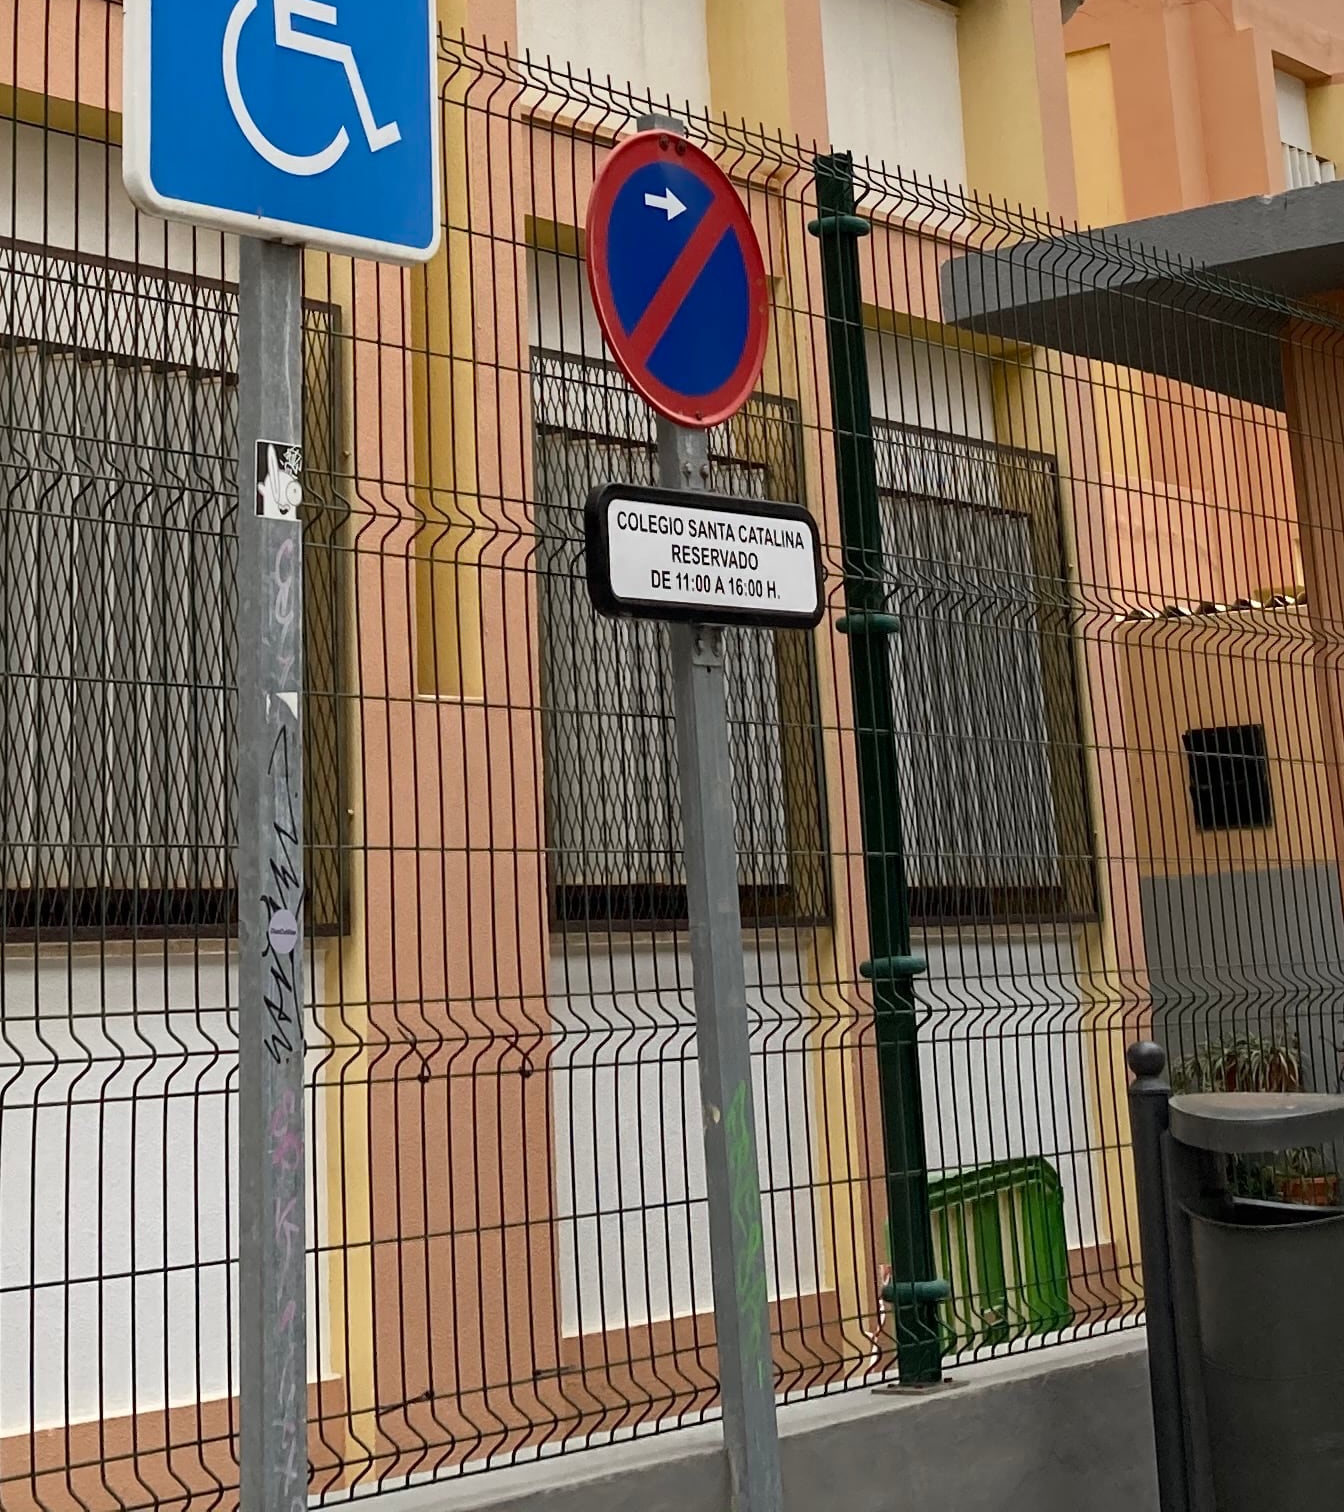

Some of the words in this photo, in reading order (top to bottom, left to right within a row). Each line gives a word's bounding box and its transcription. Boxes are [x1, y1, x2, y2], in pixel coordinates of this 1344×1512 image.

[616, 510, 684, 536] COLEGIO
[688, 519, 735, 542] SANTA
[738, 525, 805, 550] CATALINA
[671, 544, 759, 571] RESERVADO
[650, 569, 671, 590] DE
[675, 572, 711, 593] 11:00
[714, 575, 725, 594] A
[728, 577, 763, 598] 16:00
[767, 581, 781, 600] H.
